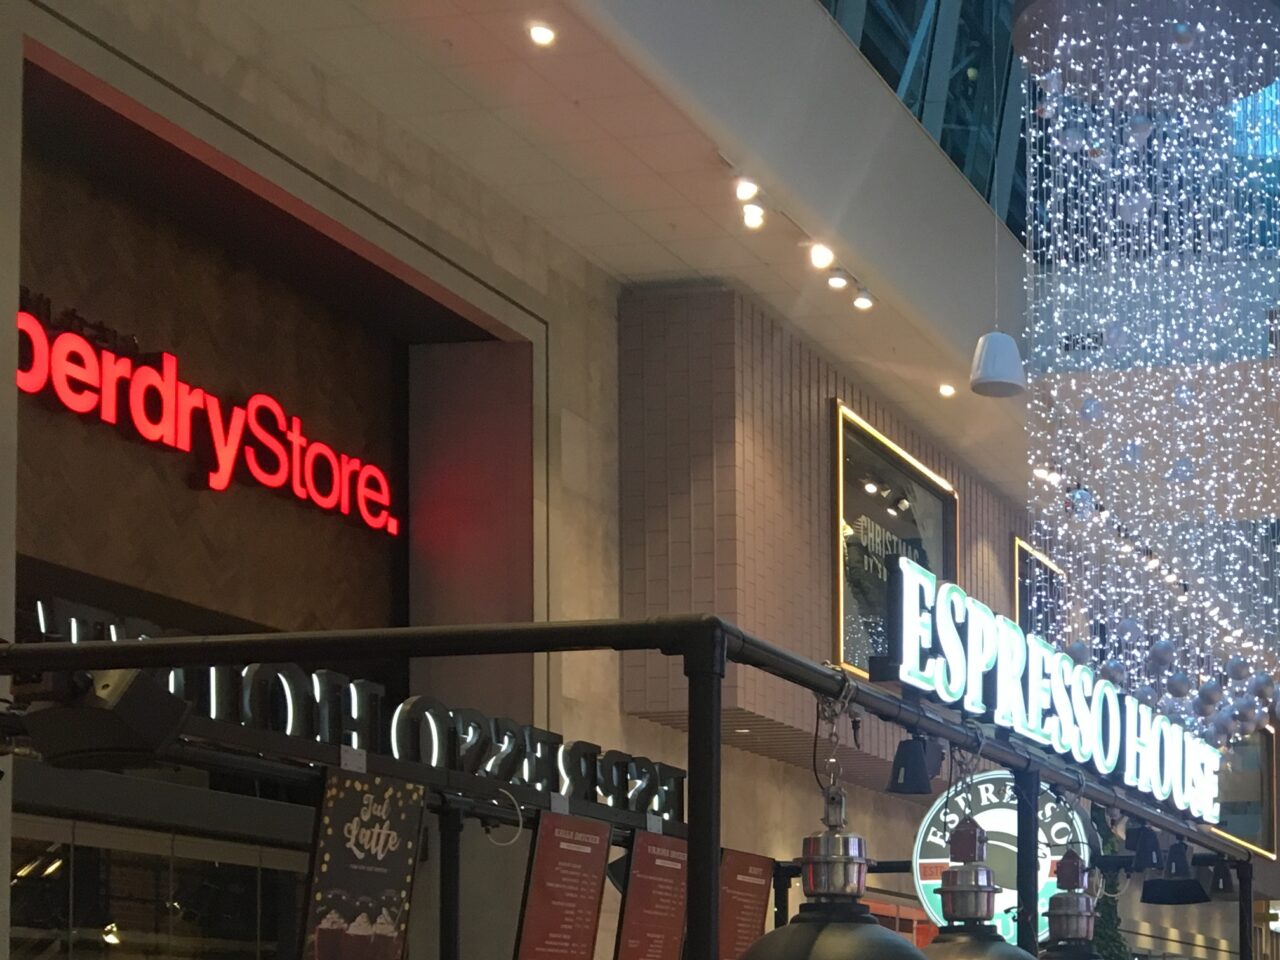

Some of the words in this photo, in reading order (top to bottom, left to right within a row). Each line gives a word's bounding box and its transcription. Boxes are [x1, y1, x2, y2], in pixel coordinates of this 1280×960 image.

[899, 556, 1120, 775] ESPRESSO
[1122, 693, 1222, 825] HOUSE
[360, 792, 391, 822] Jul
[926, 782, 1074, 849] ESPRESO
[343, 816, 401, 861] Latte
